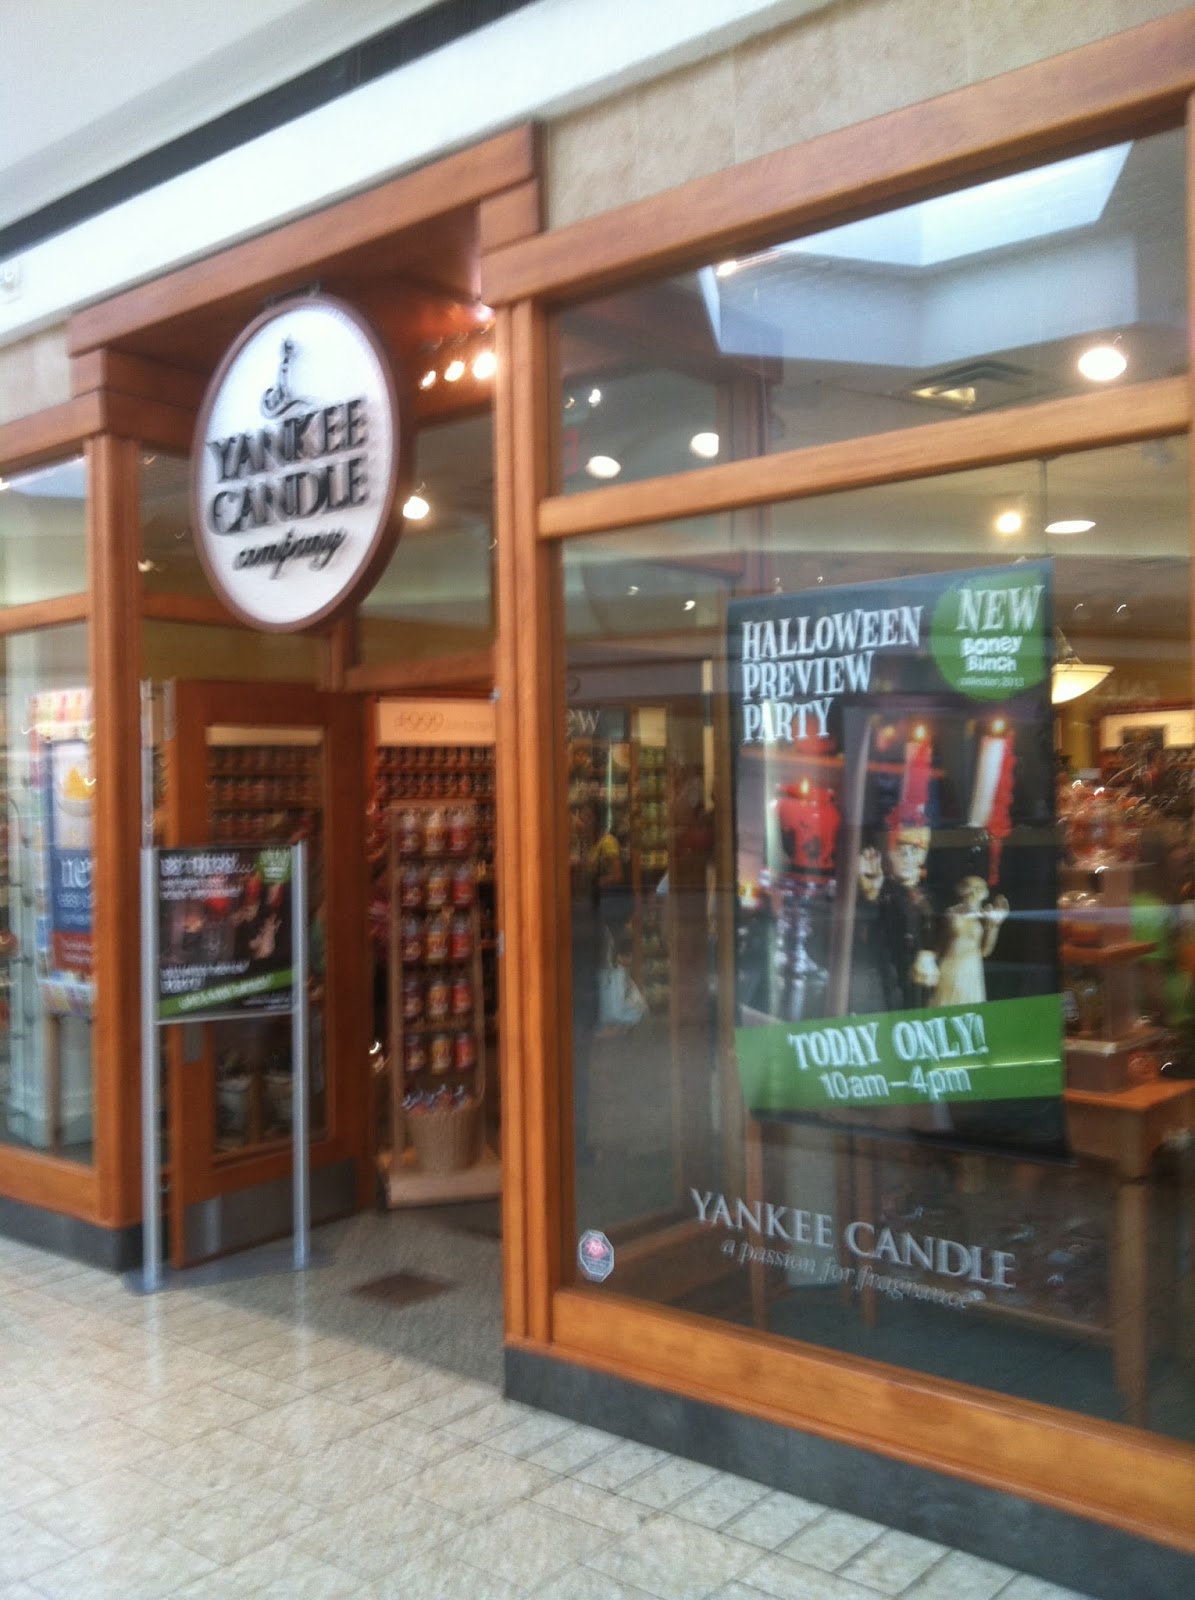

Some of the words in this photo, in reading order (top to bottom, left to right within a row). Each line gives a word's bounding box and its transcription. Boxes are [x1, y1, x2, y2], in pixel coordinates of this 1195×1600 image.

[206, 398, 367, 483] YANKEE
[207, 456, 368, 535] CANDLE
[233, 528, 347, 579] company
[741, 605, 924, 662] HALLOWEEN
[955, 585, 1045, 633] NEW
[741, 650, 874, 700] PREVIEW
[741, 697, 834, 744] PARTY
[788, 1022, 881, 1071] TODAY
[892, 1012, 989, 1062] ONLY!
[690, 1187, 834, 1249] YANKEE
[845, 1221, 1017, 1290] CANDLE
[720, 1238, 736, 1256] a
[740, 1240, 816, 1275] passion
[818, 1256, 856, 1285] for
